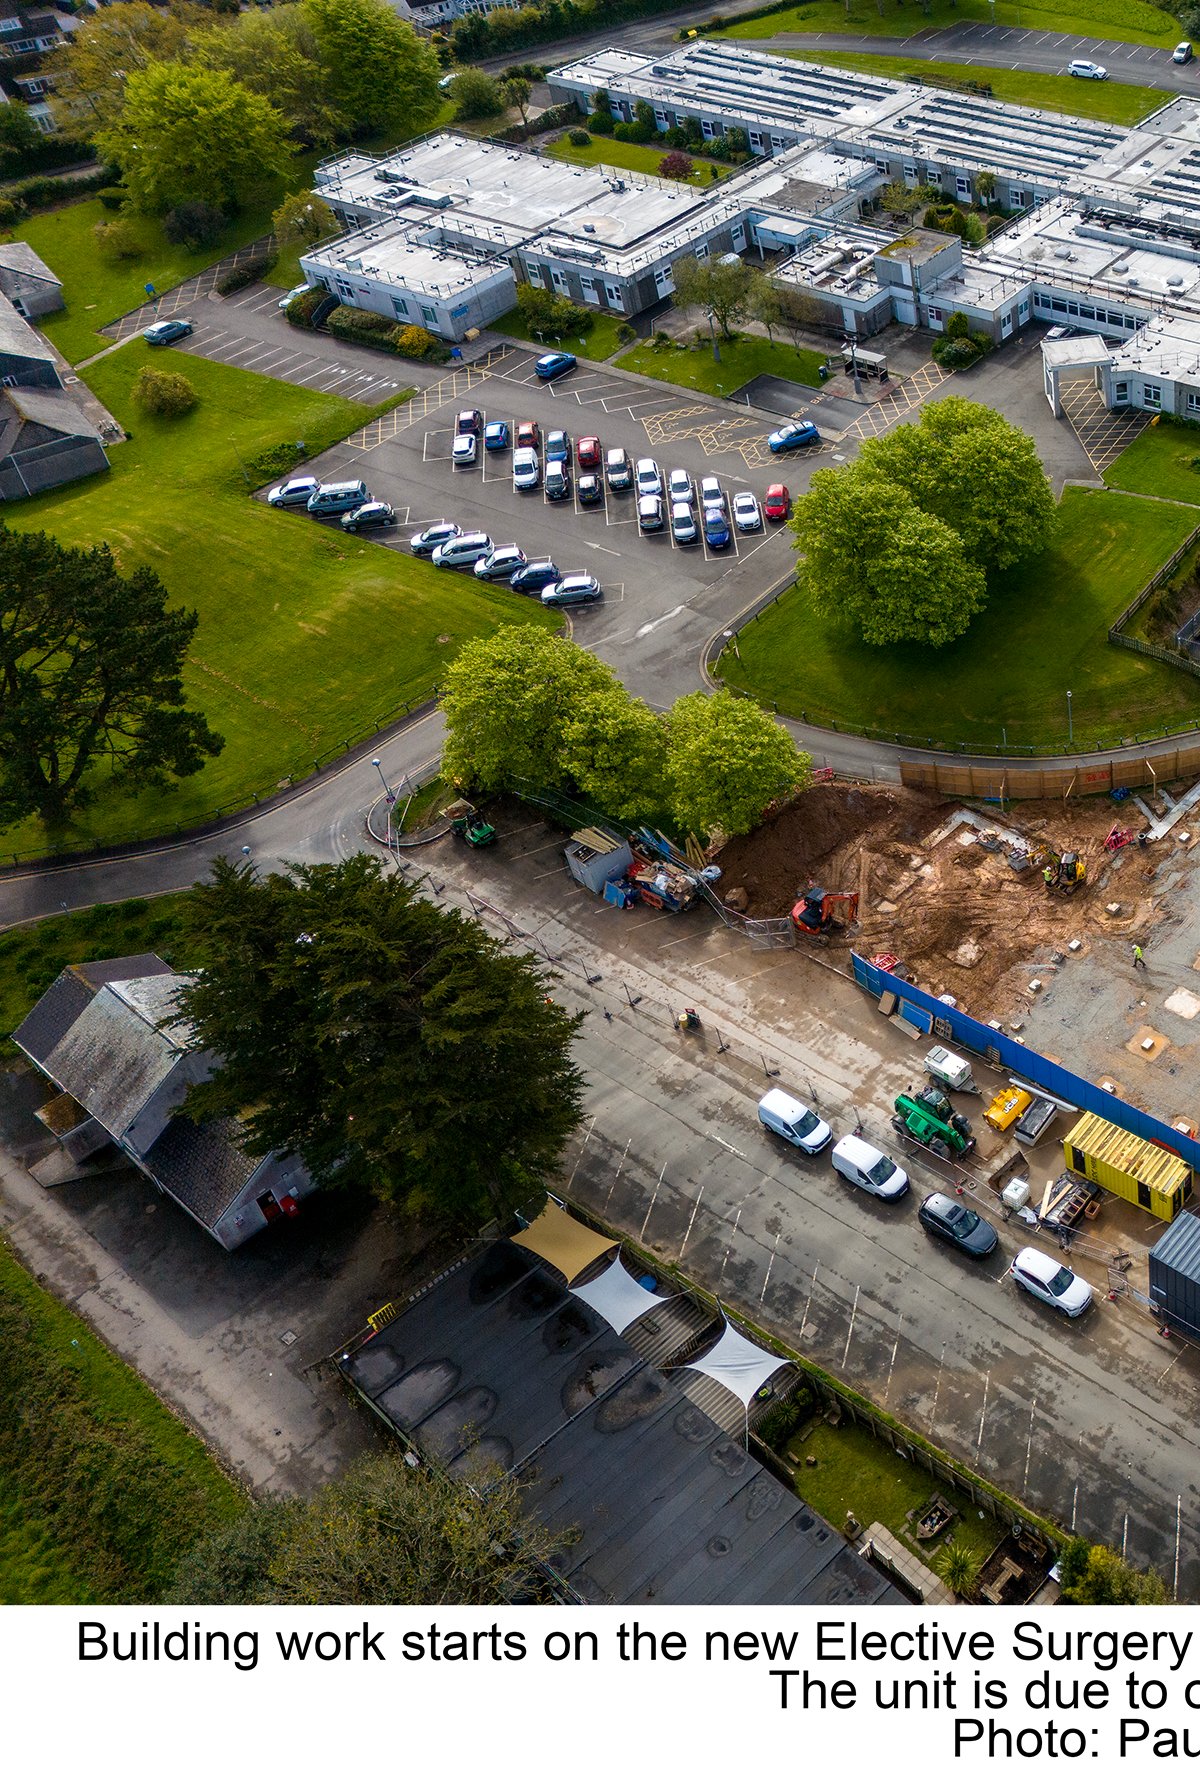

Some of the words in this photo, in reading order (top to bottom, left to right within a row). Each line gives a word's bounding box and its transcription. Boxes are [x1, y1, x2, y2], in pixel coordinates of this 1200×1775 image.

[790, 406, 810, 419] BUS
[809, 392, 827, 405] BAY
[1003, 1098, 1019, 1114] JCB
